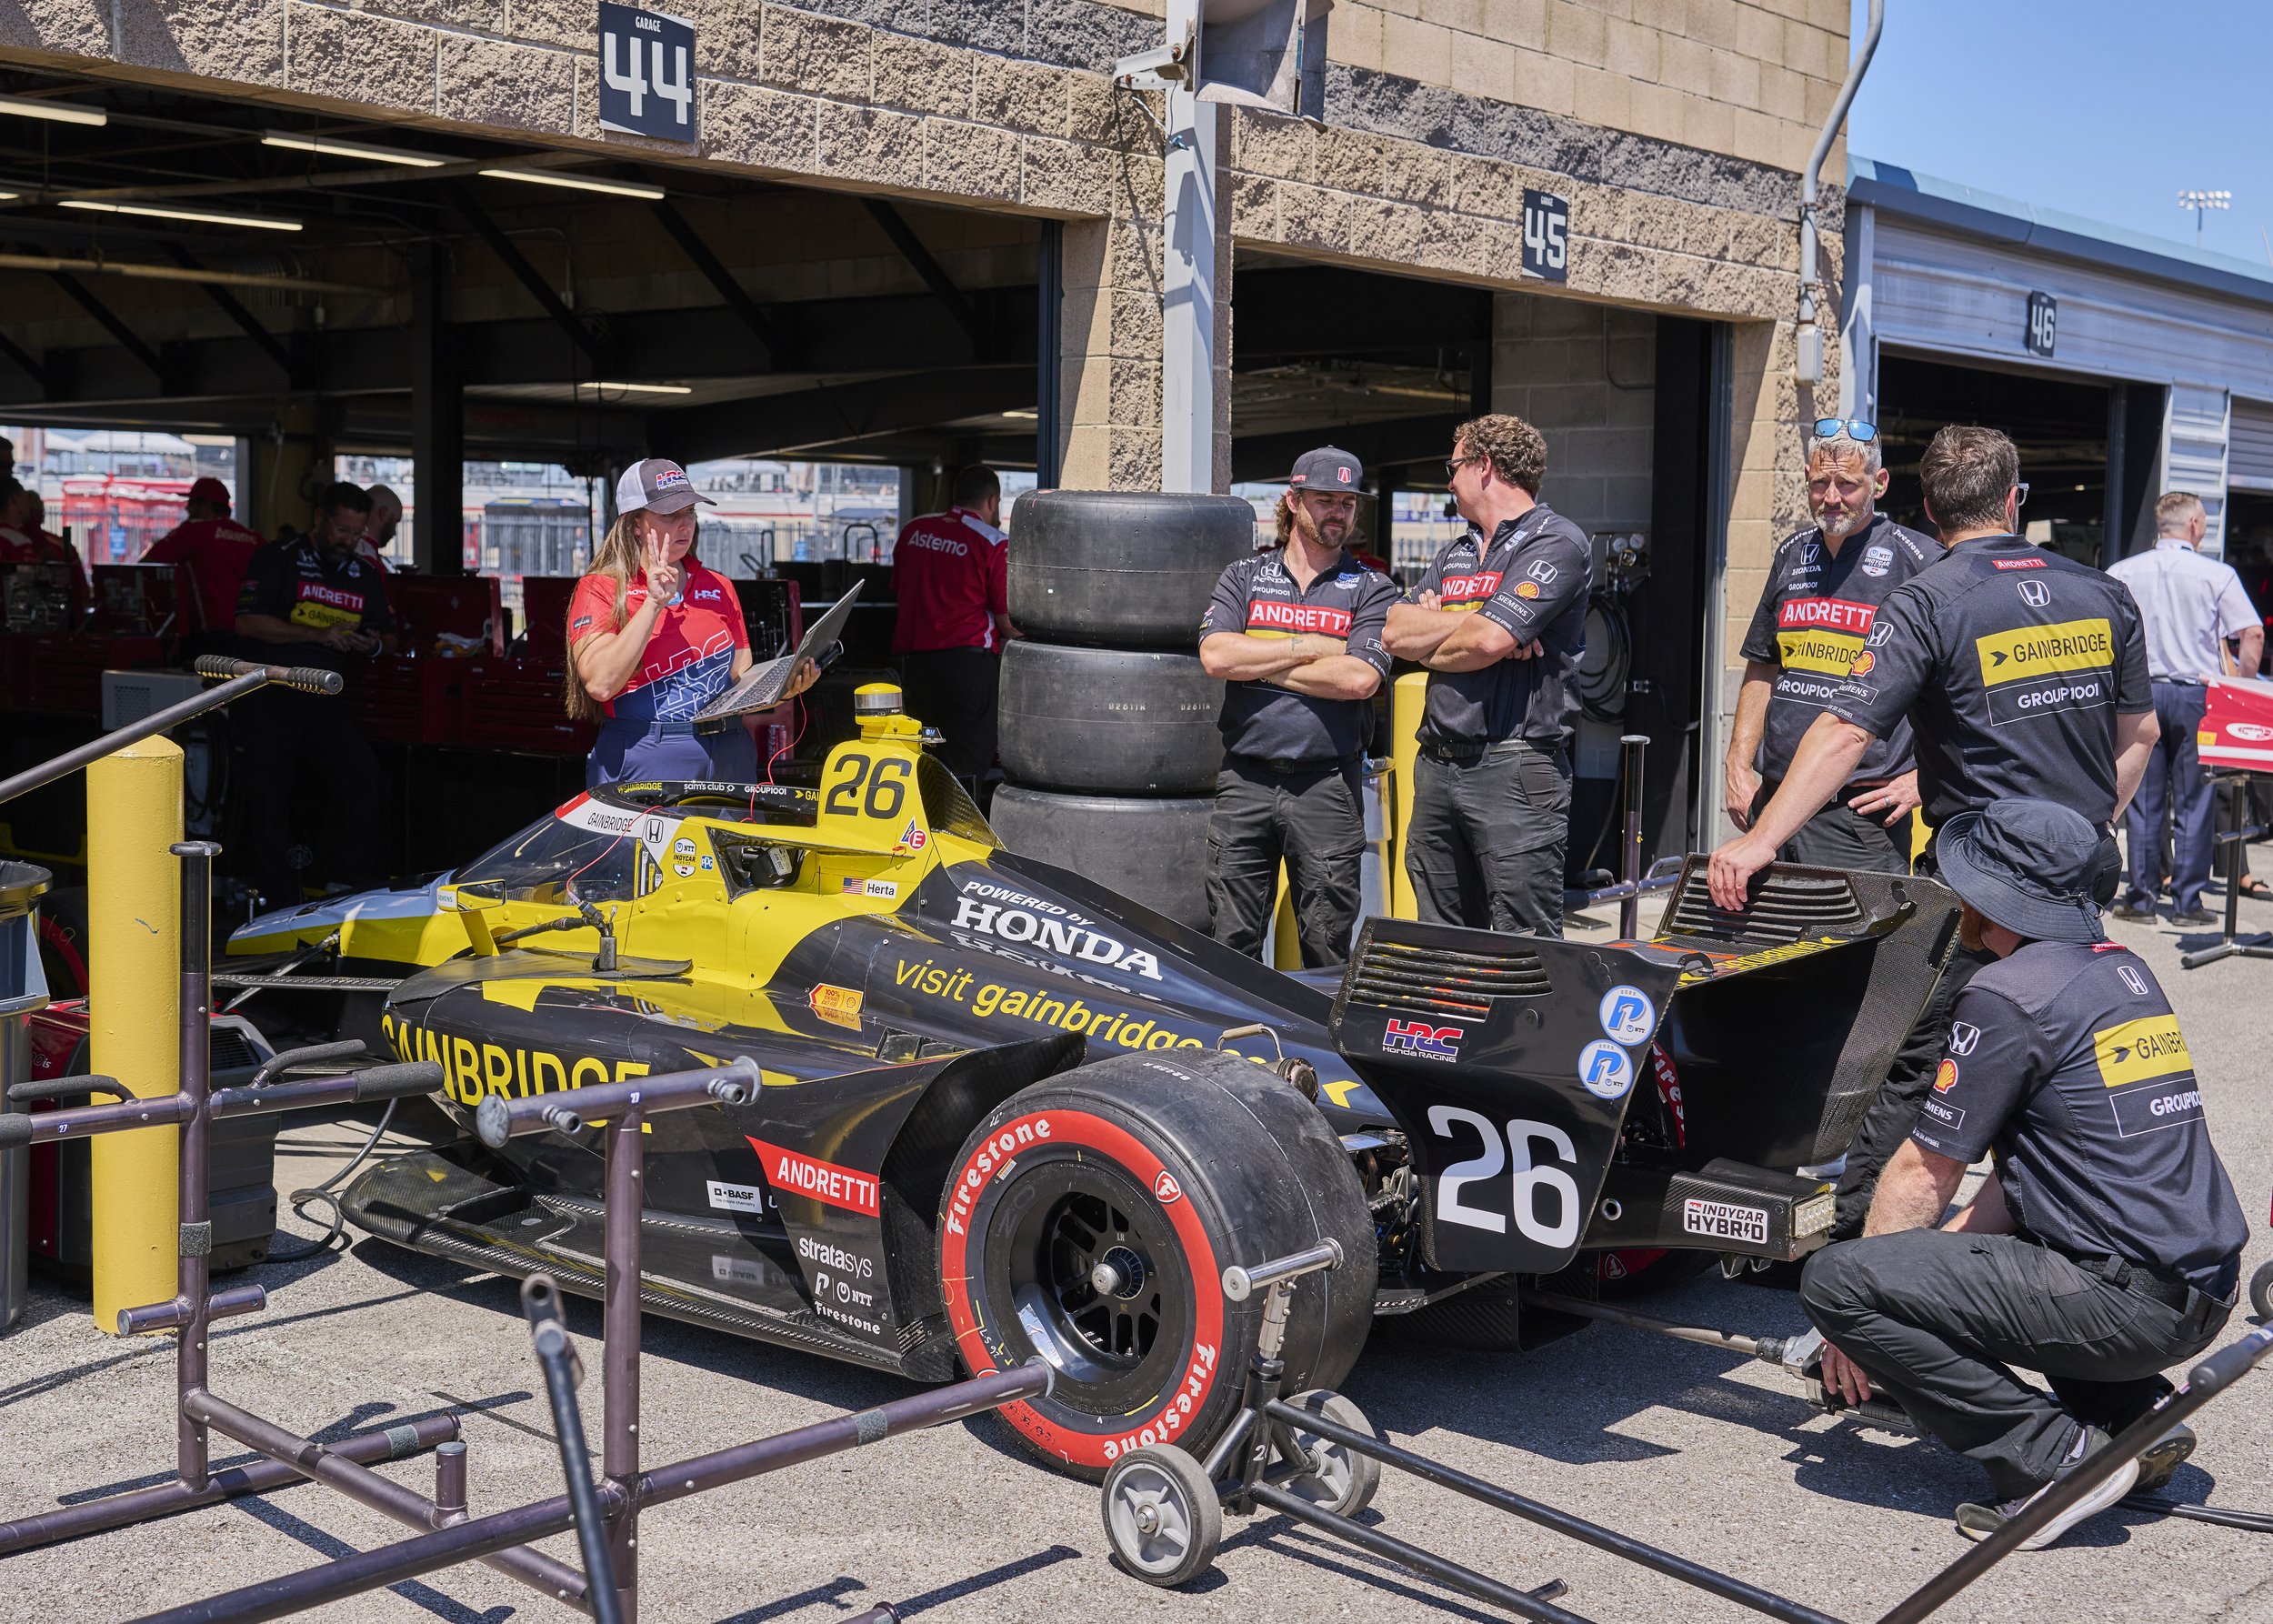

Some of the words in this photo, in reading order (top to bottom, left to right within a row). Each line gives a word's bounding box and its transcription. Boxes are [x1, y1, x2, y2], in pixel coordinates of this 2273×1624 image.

[635, 15, 661, 33] GARAGE
[604, 31, 692, 125] 44
[1525, 207, 1566, 269] 45
[2031, 305, 2055, 348] 46
[907, 529, 968, 556] Astemo
[1792, 565, 1822, 576] HONDA
[1997, 558, 2045, 568] ANDRETTI
[302, 585, 364, 609] ANDRETTI
[1251, 585, 1291, 596] GROUP1001
[1497, 594, 1528, 617] SIEMENS
[2013, 633, 2107, 663] GAINBRIDGE
[2018, 682, 2099, 709] GROUP1001
[706, 782, 725, 791] club
[744, 785, 787, 796] GROUP1001
[824, 753, 913, 820] 26
[587, 812, 632, 833] GAINBRIDGE
[673, 854, 696, 863] INDYCAR
[684, 845, 696, 853] NTT
[701, 857, 714, 869] PPG
[866, 882, 896, 897] Herta
[964, 880, 1067, 917] POWERED
[1069, 911, 1096, 927] by
[950, 896, 1164, 981] HONDA
[895, 958, 974, 1002] visit
[1382, 1018, 1464, 1057] HRC
[1382, 1045, 1417, 1058] Honda
[1418, 1050, 1457, 1063] RACING
[630, 1092, 640, 1103] 27
[59, 1124, 68, 1133] 27
[777, 1156, 876, 1208] ANDRETTI
[946, 1118, 1051, 1236] Firestone
[1427, 1105, 1579, 1248] 26
[727, 1189, 754, 1200] BASF
[1702, 1203, 1764, 1224] INDYCAR
[1116, 1232, 1126, 1242] LR
[798, 1237, 873, 1279] stratasys
[851, 1289, 873, 1307] NTT
[813, 1300, 881, 1335] Firestone
[1103, 1342, 1217, 1460] Firestone
[1253, 1444, 1269, 1462] 2
